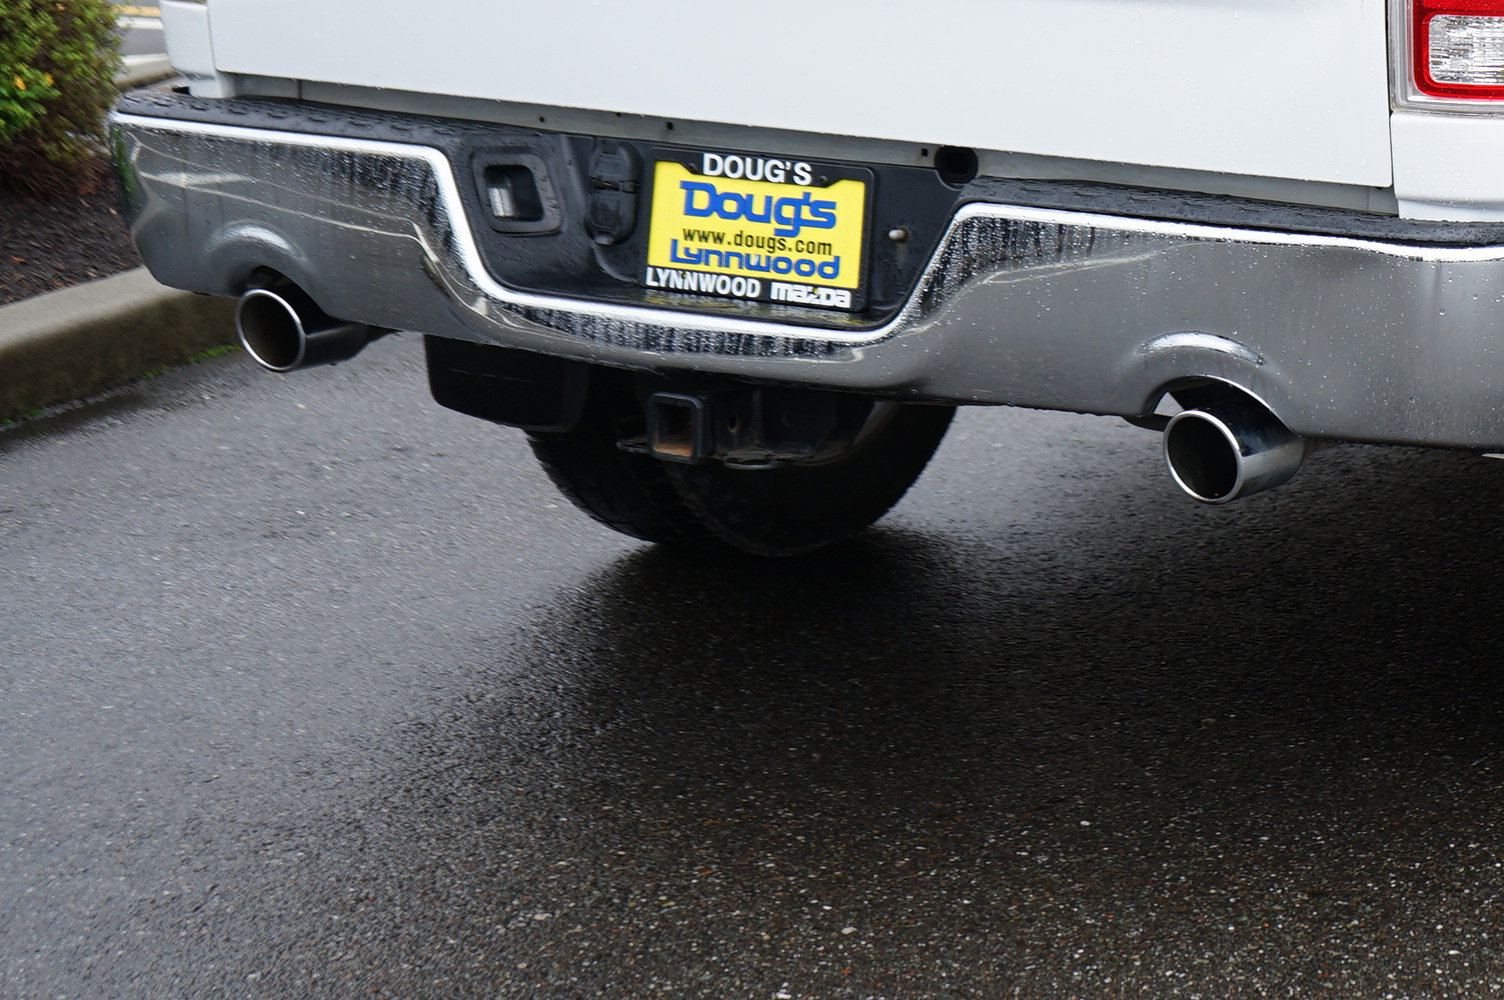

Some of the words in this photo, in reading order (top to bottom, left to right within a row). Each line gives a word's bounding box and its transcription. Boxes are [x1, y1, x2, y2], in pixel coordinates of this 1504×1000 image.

[702, 153, 812, 185] DOUG'S
[680, 180, 836, 238] Doug's
[683, 226, 832, 256] www.dougs.com
[670, 239, 840, 279] Lynnwood
[646, 267, 760, 298] LYNNWOOD
